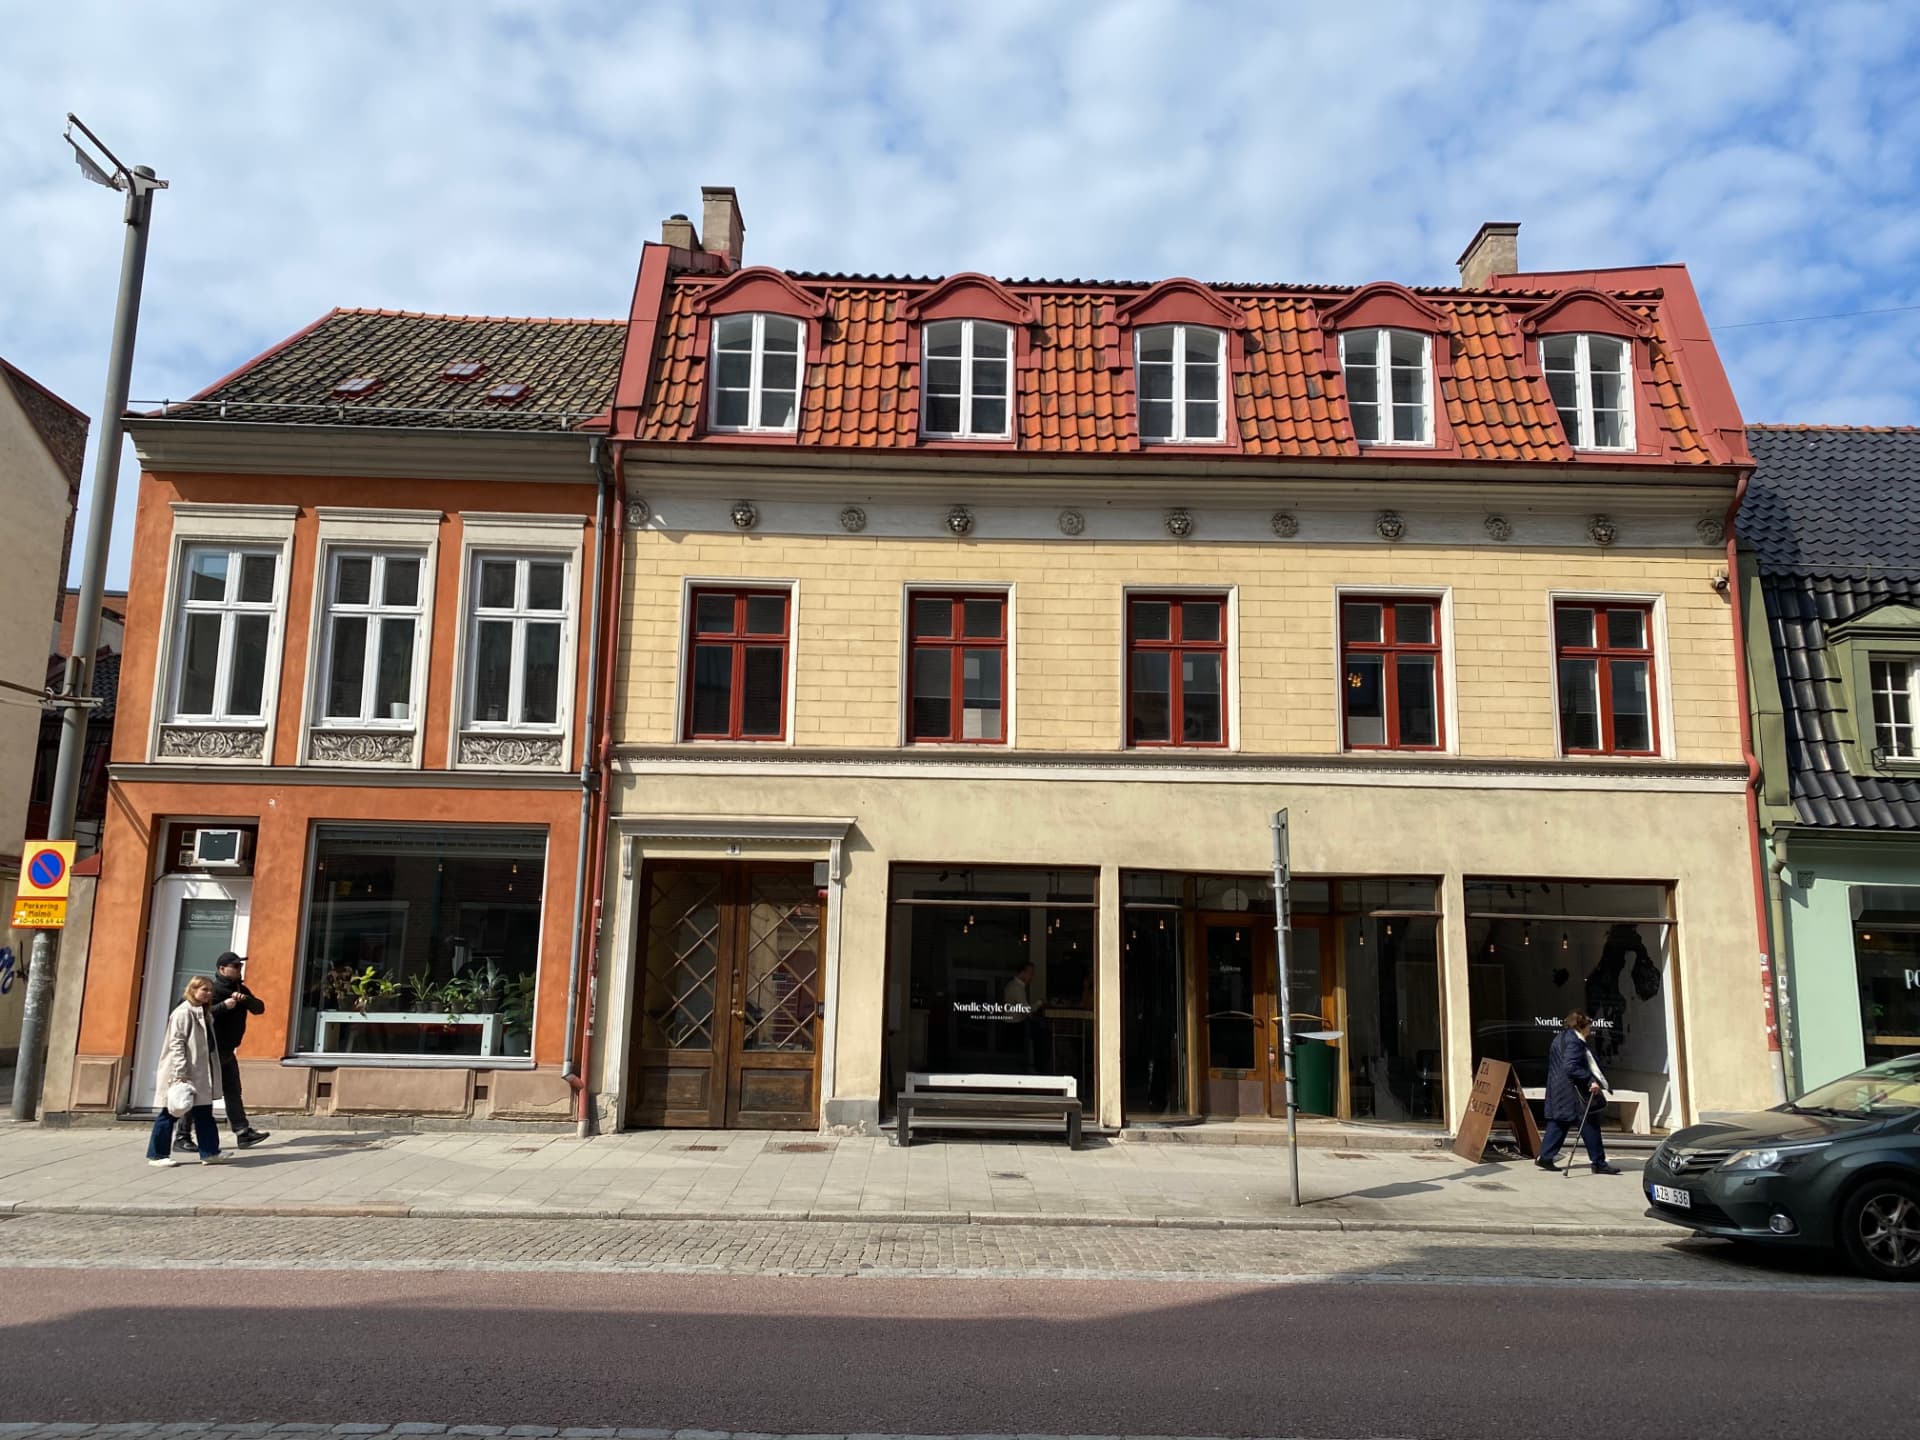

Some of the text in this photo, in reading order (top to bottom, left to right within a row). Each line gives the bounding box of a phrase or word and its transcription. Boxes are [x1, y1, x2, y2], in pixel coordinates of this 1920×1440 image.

[23, 902, 59, 911] Parkering
[953, 1002, 1032, 1014] Nordic Style Coffee
[1535, 1016, 1614, 1028] Nordic offee
[1673, 1190, 1689, 1205] 536
